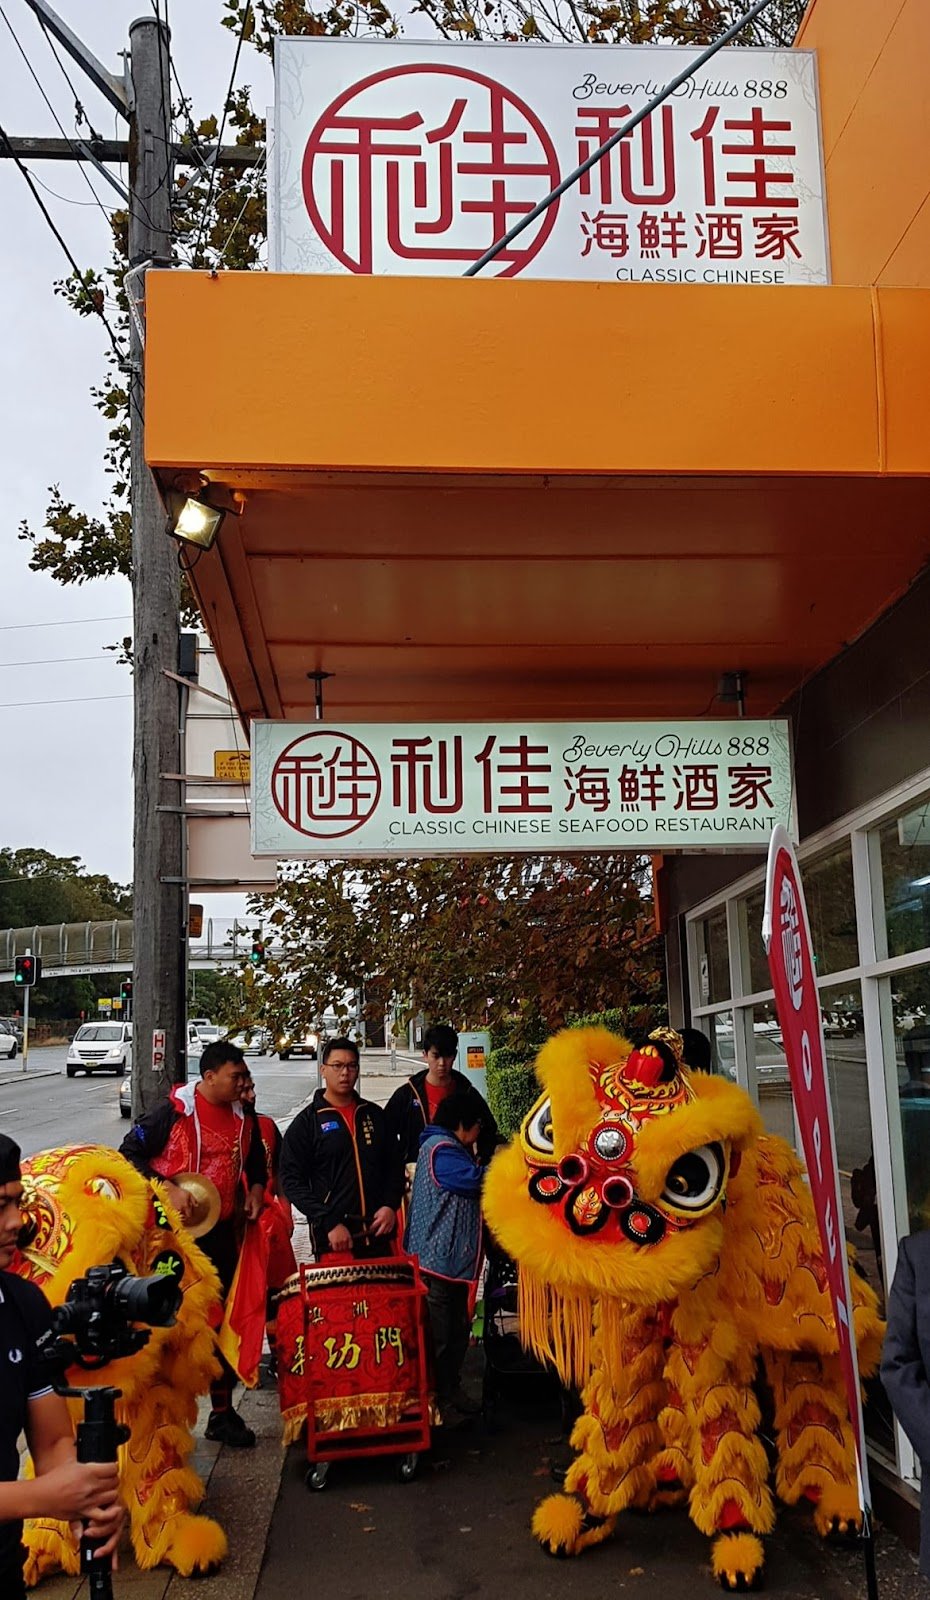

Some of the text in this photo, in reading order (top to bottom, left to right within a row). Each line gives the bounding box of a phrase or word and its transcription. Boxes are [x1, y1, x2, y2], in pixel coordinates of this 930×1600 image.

[672, 76, 739, 99] Hills
[744, 79, 788, 99] 888
[575, 104, 799, 208] 利佳
[580, 210, 802, 260] 海鮮酒家
[616, 267, 785, 284] CLASSIC CHINESE
[562, 734, 769, 763] Beverly Hills 888
[391, 735, 552, 814] 利佳
[564, 763, 774, 812] 海鮮酒家
[389, 816, 776, 835] CLASSIC CHINESE SEAFOOD RESTAURANT
